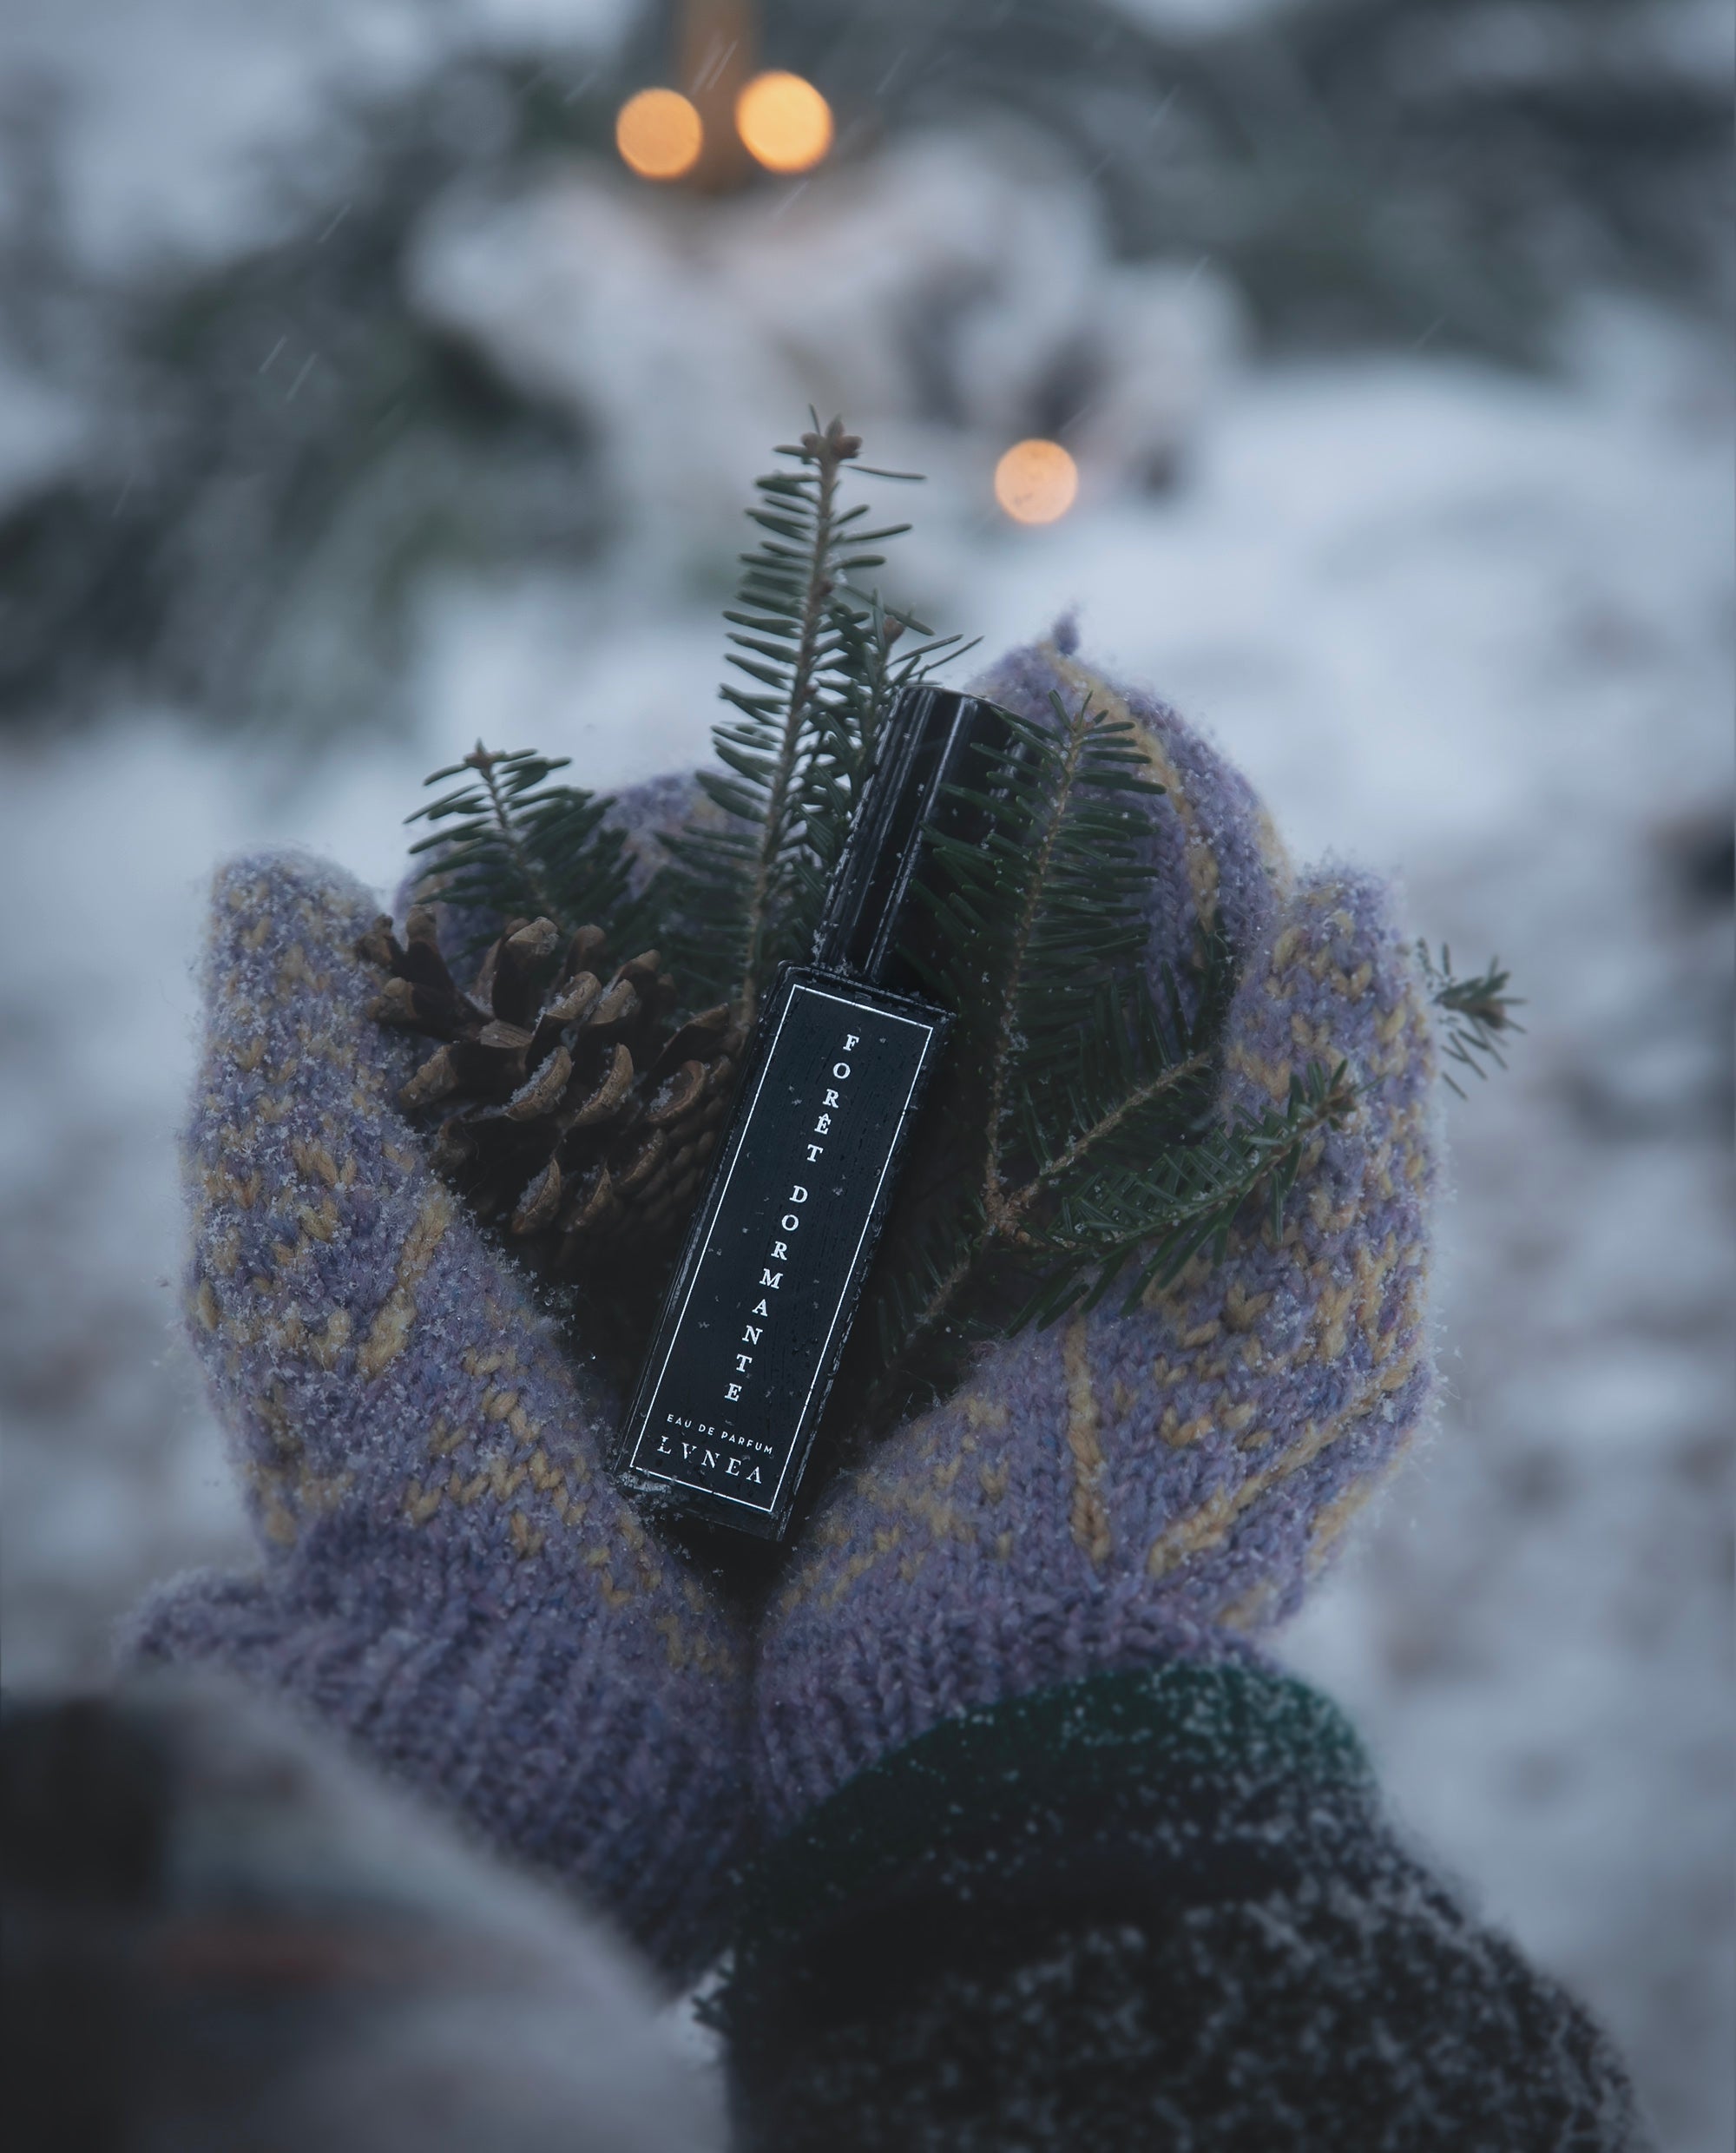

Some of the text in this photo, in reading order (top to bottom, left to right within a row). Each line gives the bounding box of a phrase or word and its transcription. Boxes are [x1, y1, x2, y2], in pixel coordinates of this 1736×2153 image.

[725, 1034, 859, 1401] FORÊT DORMANTE
[667, 1414, 773, 1455] EAU DE PARFUM
[657, 1435, 762, 1485] LVNEA
